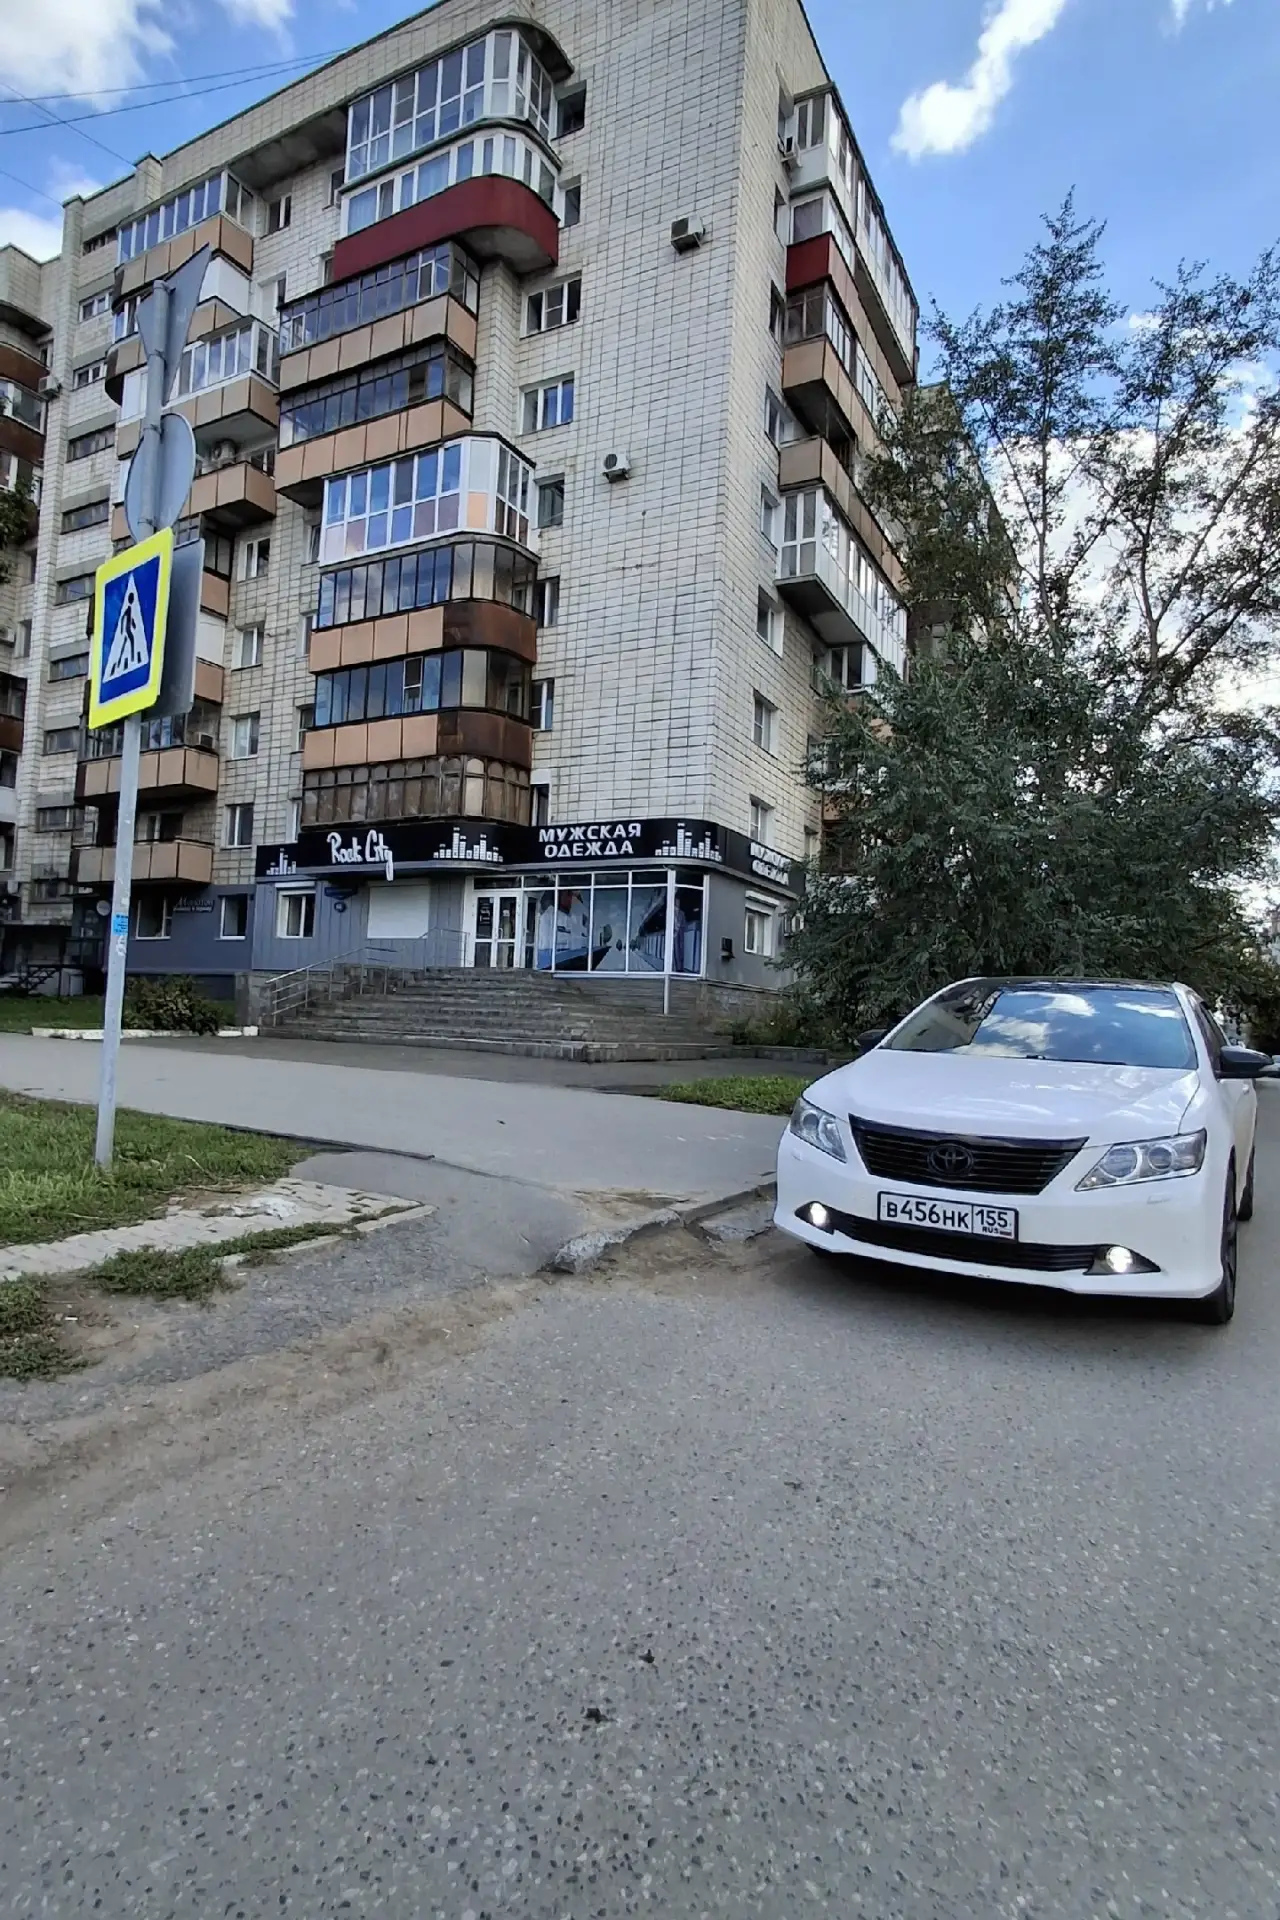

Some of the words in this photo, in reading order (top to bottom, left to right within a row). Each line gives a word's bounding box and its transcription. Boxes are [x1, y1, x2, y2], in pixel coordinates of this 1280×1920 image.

[539, 823, 641, 842] МУЖСКАЯ
[326, 832, 363, 864] Rock
[365, 829, 394, 881] City
[544, 840, 634, 858] ОДЕЖДА
[886, 1200, 969, 1229] В456НК
[975, 1209, 1008, 1228] 155
[982, 1226, 999, 1234] RUS
